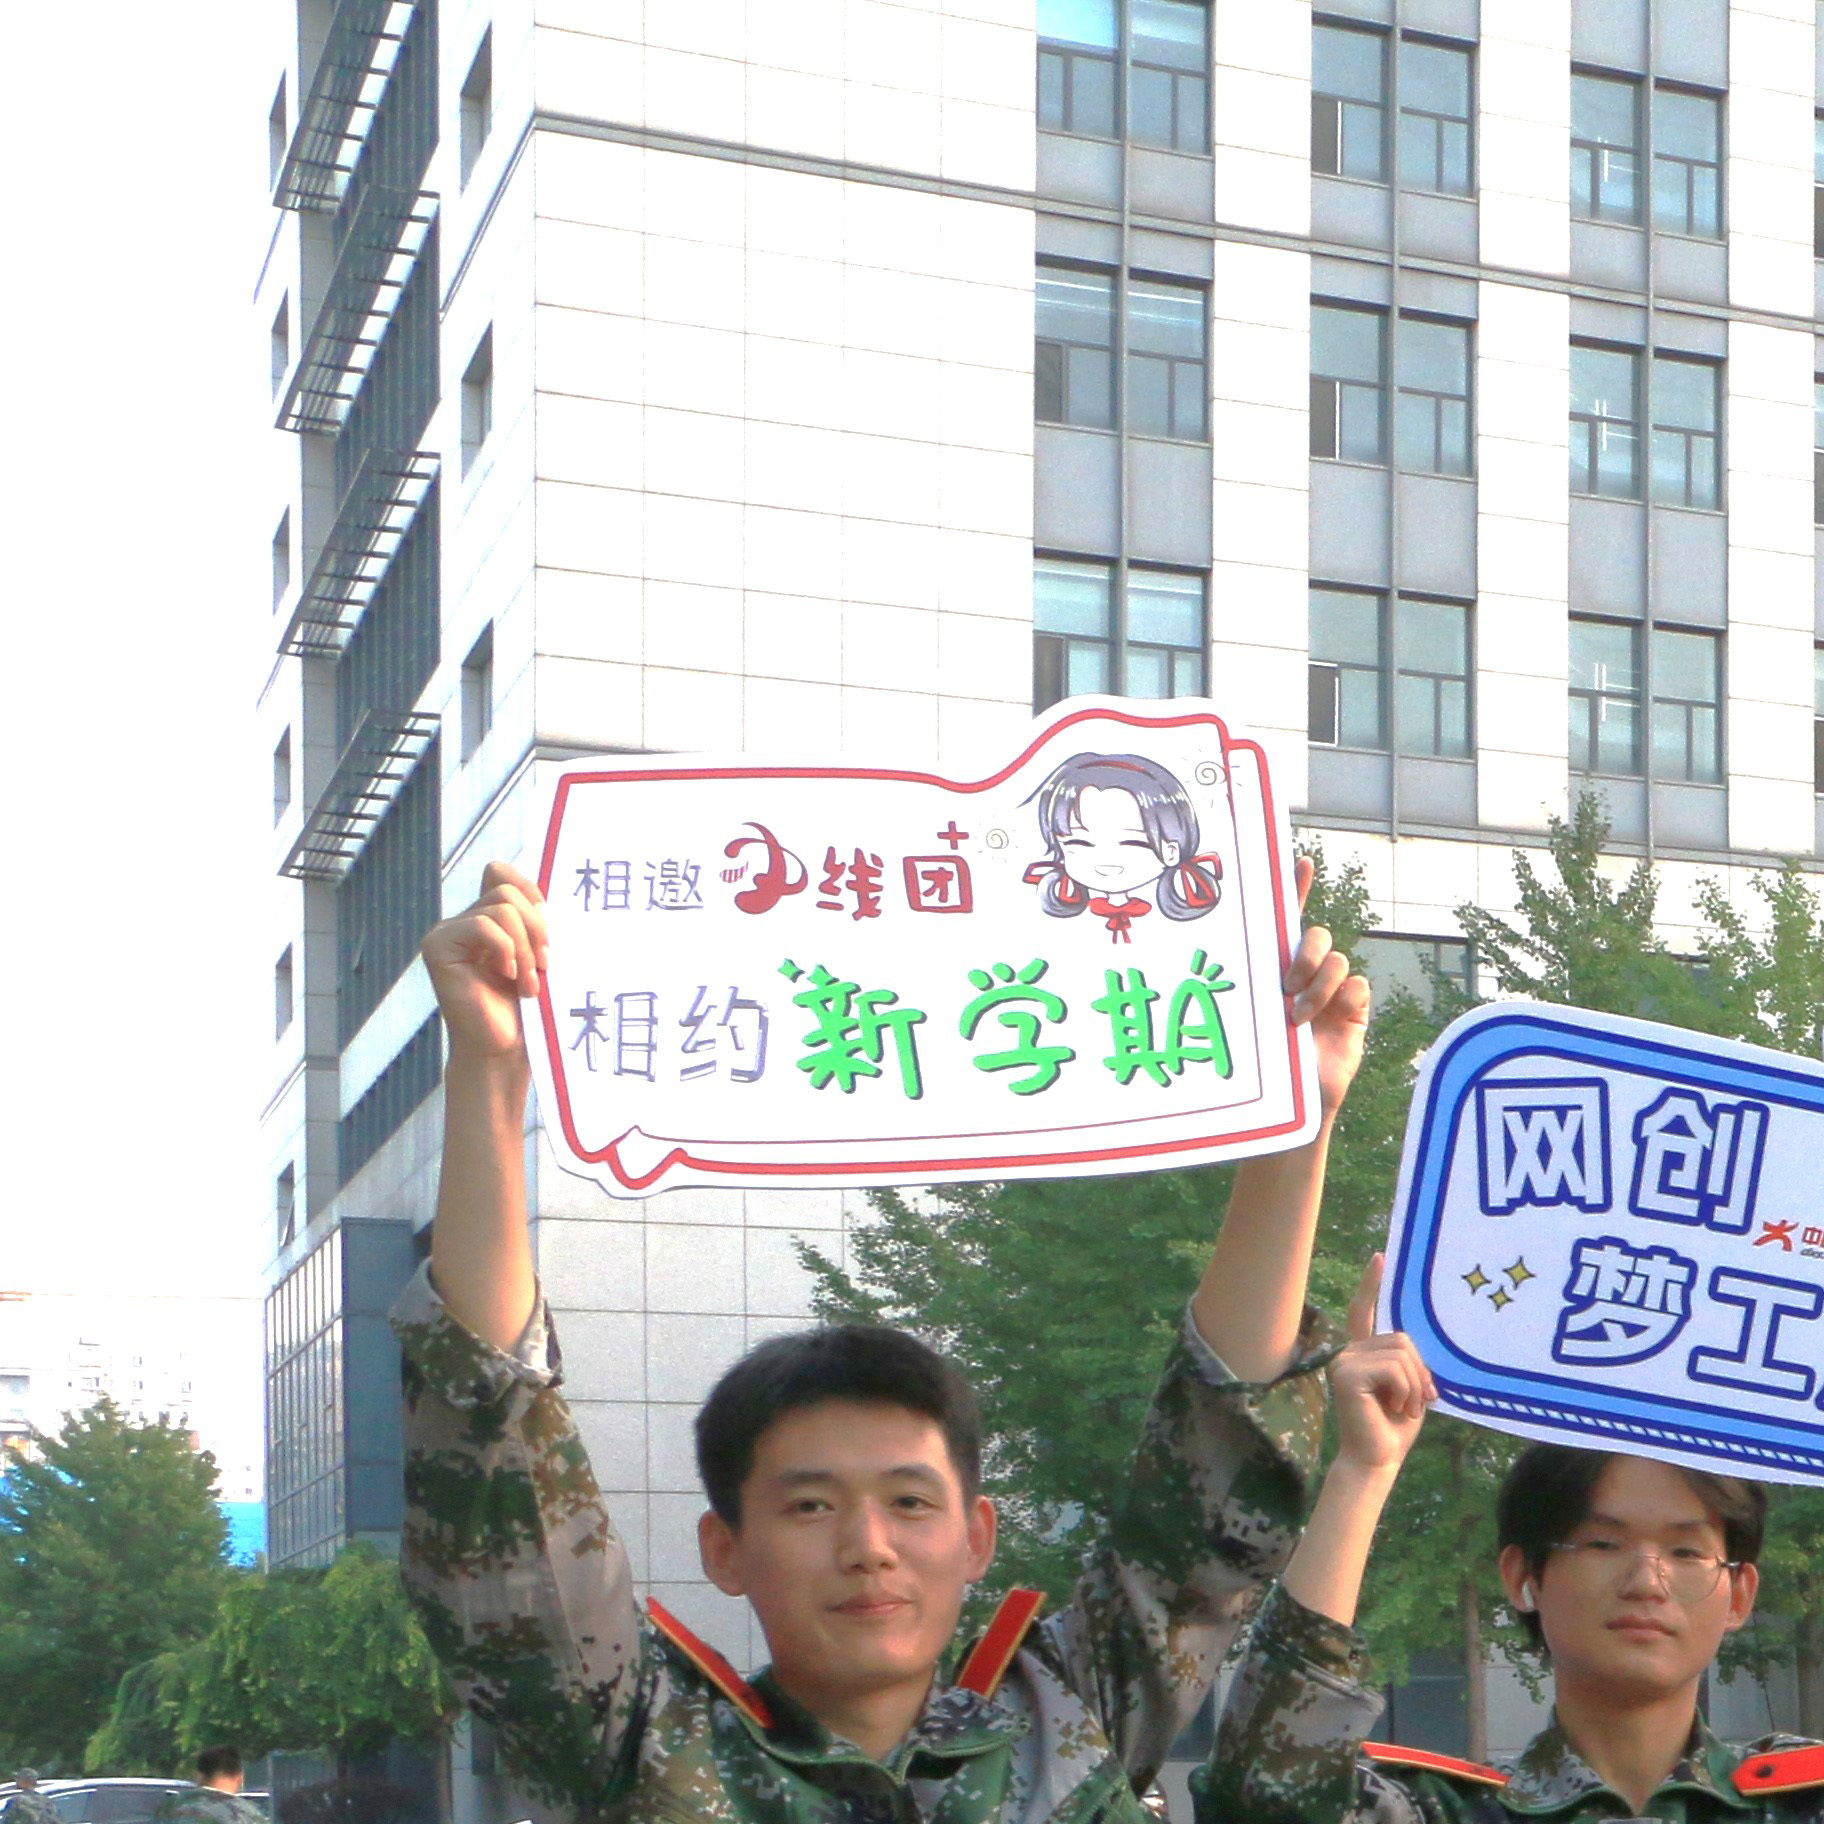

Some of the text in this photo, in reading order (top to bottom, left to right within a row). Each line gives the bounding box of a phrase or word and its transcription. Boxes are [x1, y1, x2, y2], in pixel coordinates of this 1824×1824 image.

[568, 950, 1236, 1102] 相约新学期
[1474, 1078, 1769, 1236] 网创
